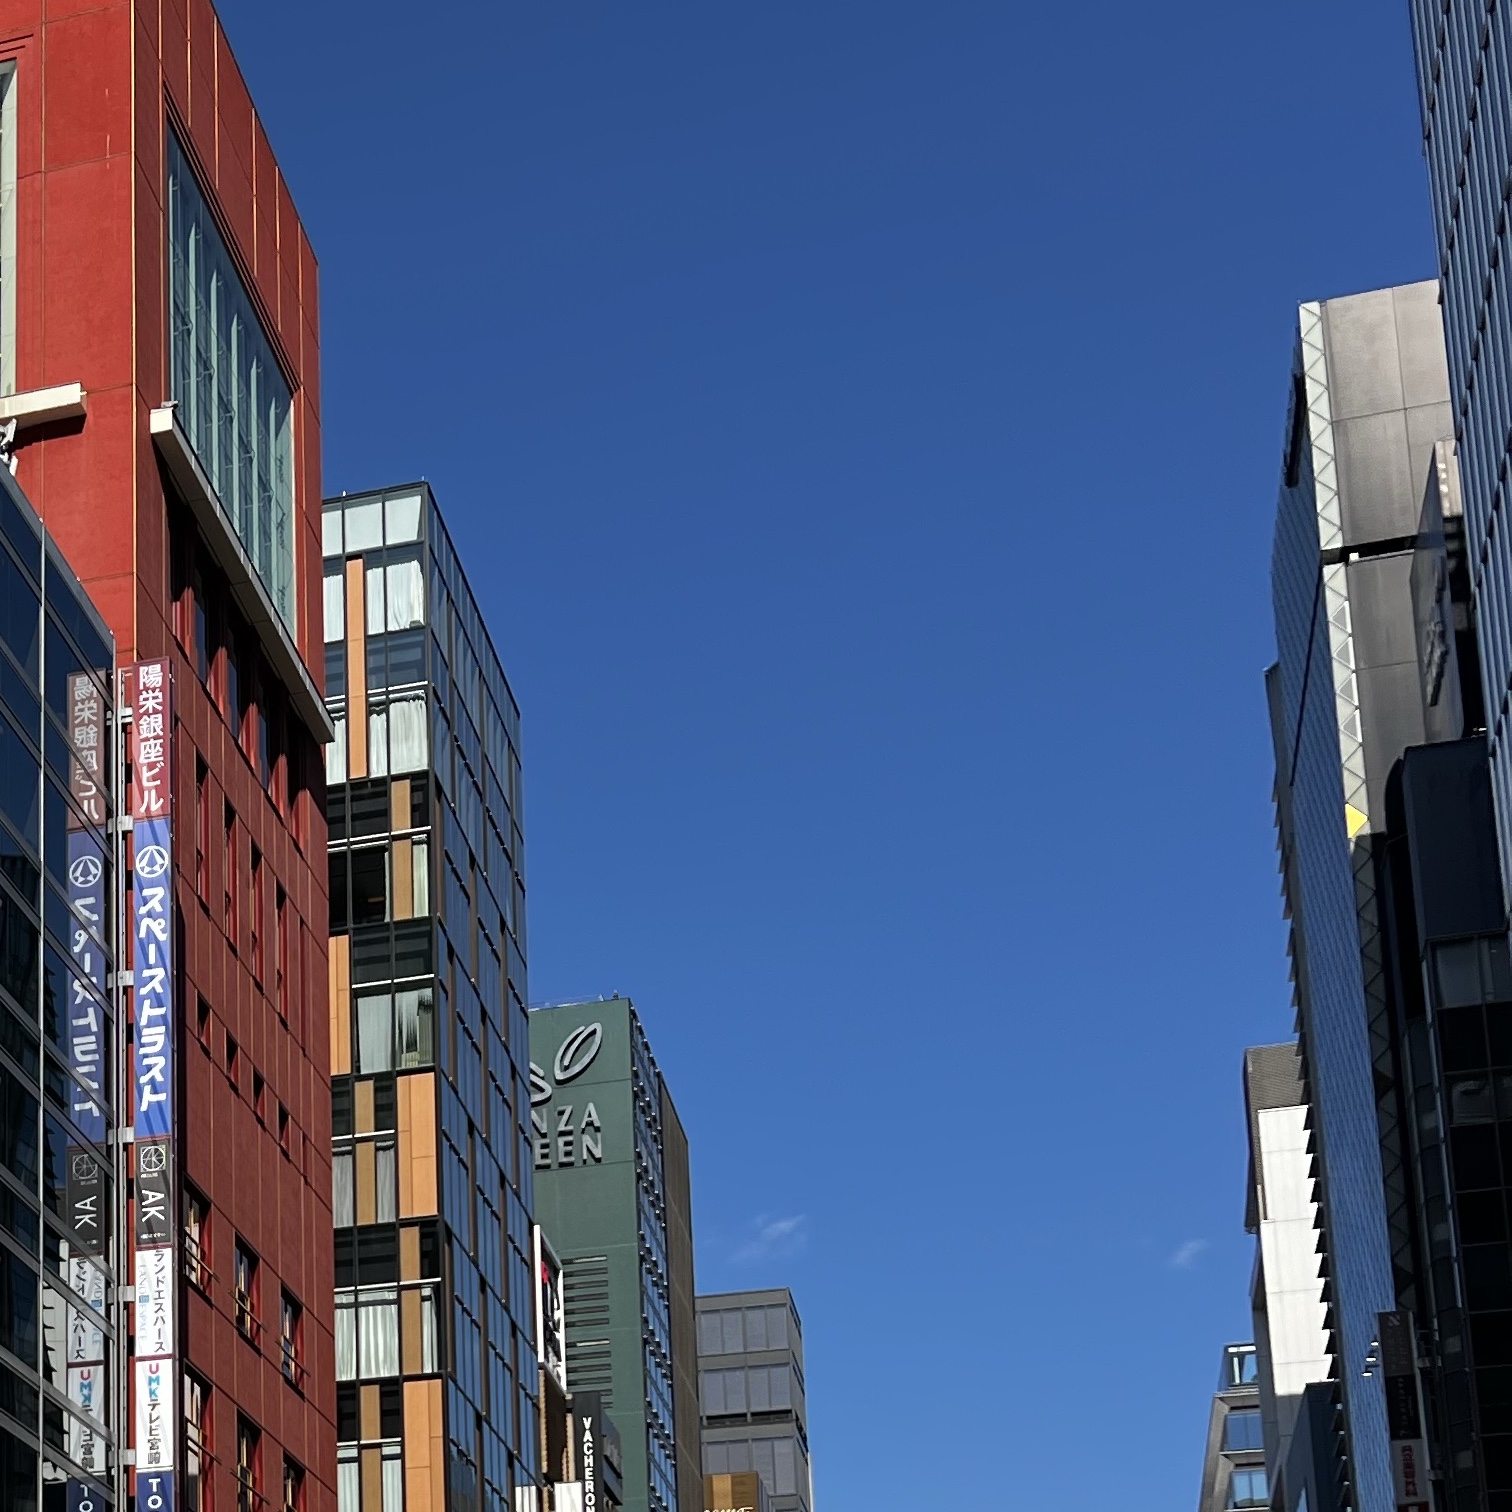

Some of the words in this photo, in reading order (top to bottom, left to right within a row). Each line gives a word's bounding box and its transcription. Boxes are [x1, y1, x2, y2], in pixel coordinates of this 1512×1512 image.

[138, 663, 165, 814] 陽栄銀座ビル
[138, 886, 167, 1113] スペーストラスト
[141, 1189, 165, 1223] AK
